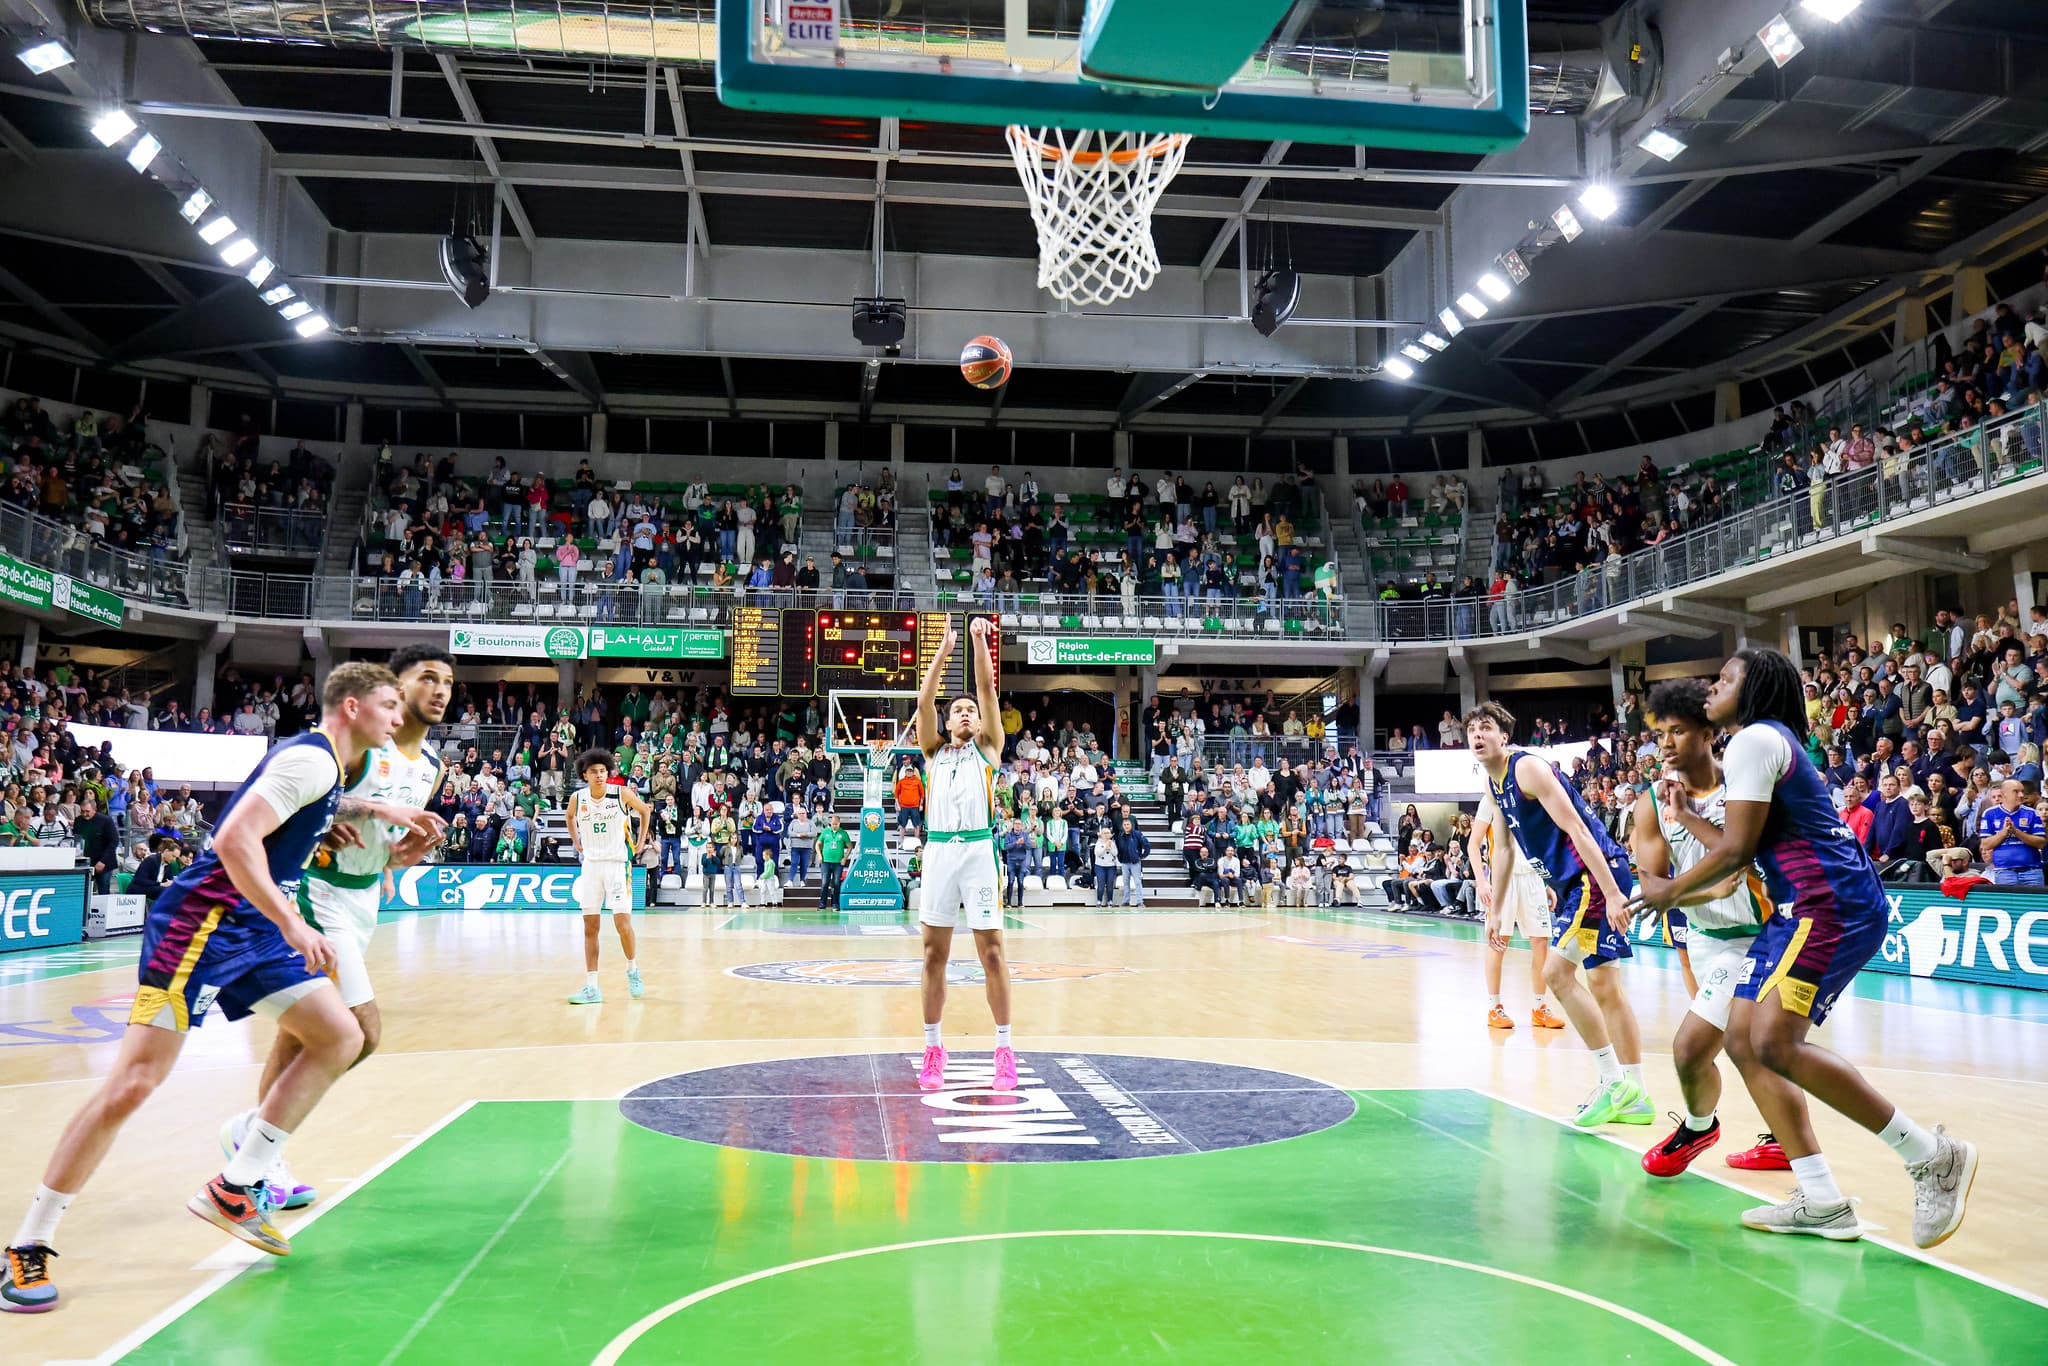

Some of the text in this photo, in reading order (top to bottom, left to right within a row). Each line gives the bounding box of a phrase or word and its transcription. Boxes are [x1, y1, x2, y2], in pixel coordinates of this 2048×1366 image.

[789, 22, 832, 40] ÉLITE
[71, 584, 90, 599] Région
[71, 597, 121, 624] Hauts-de-France
[478, 637, 541, 648] Boulonnais
[592, 631, 679, 648] FLAHAUT
[1059, 643, 1089, 651] Région
[1809, 632, 1824, 654] L
[1059, 652, 1152, 661] Hauts-de-France
[646, 671, 695, 682] V & W
[1629, 670, 1642, 689] K
[593, 822, 607, 833] 62
[439, 868, 462, 884] EX
[1886, 895, 1904, 923] X
